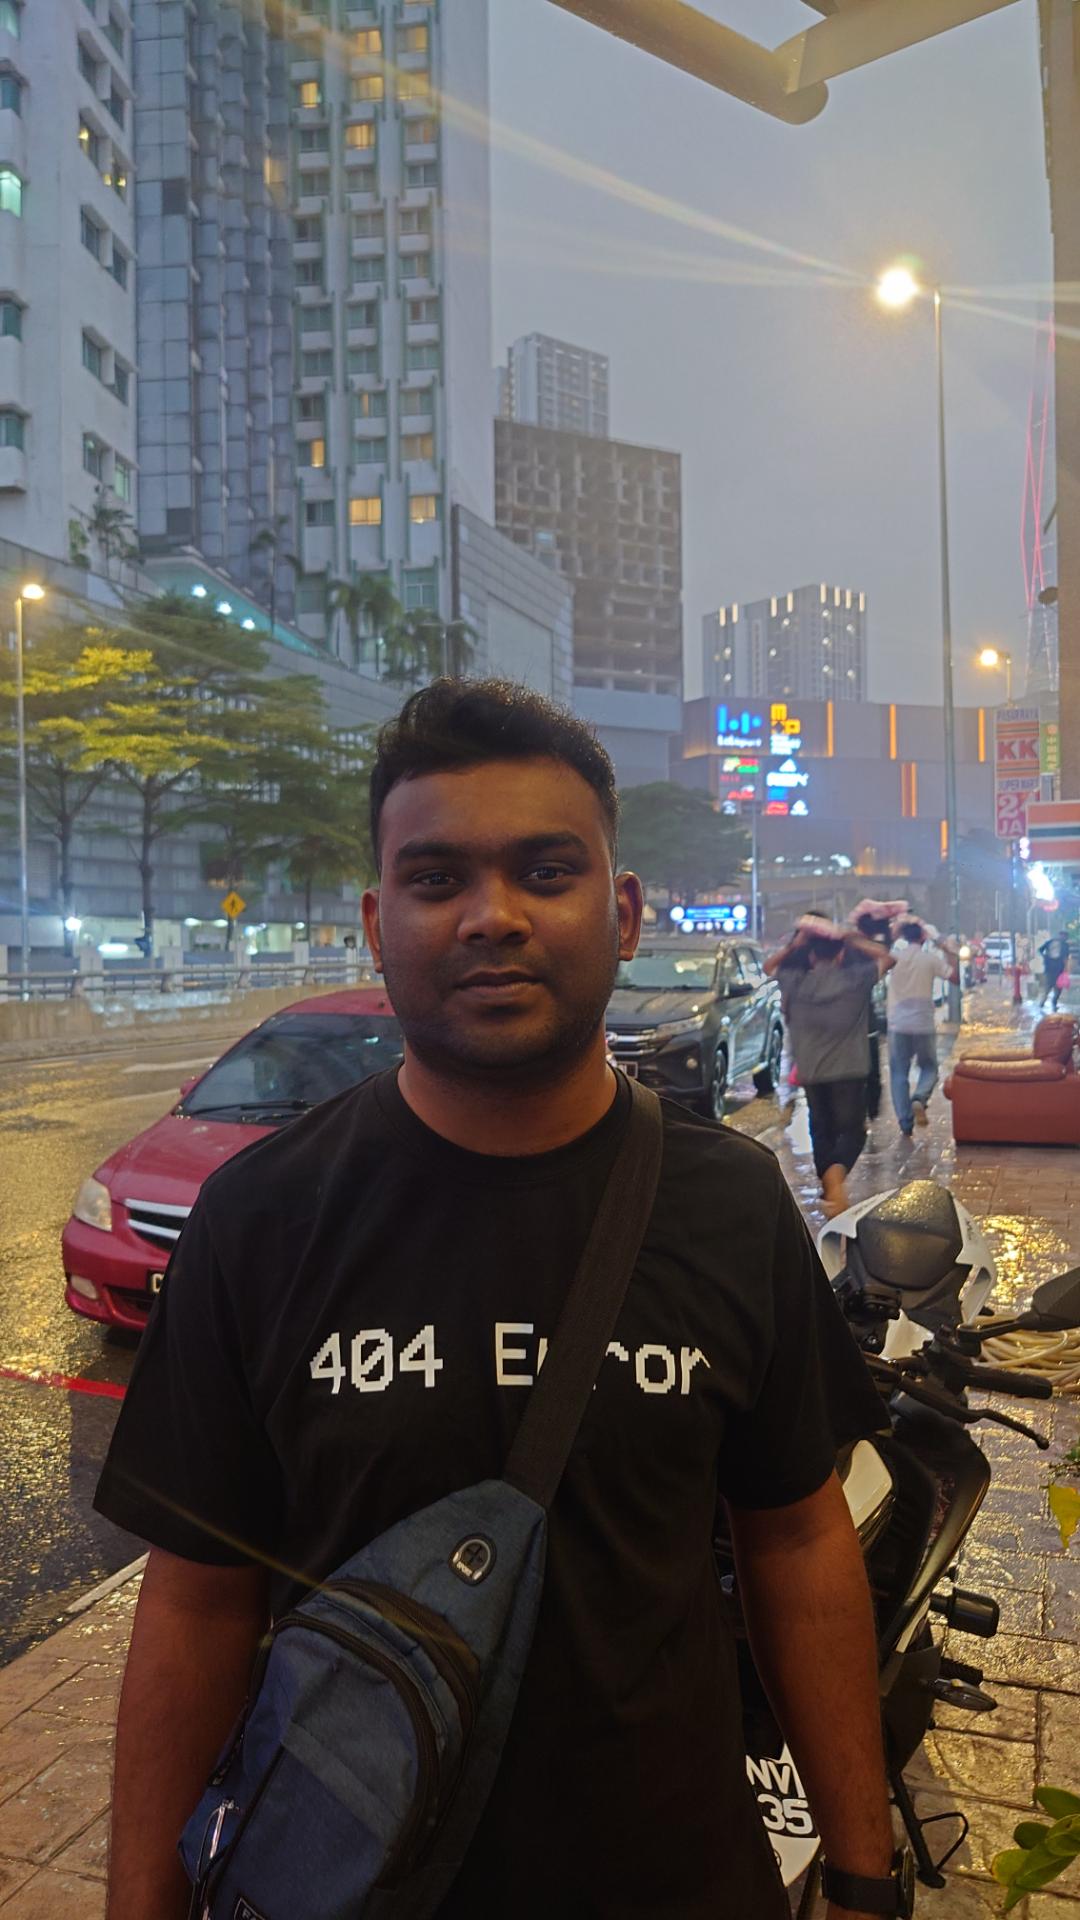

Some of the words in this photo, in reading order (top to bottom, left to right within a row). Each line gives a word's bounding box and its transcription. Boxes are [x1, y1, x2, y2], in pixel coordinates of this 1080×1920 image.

[997, 740, 1038, 760] KK
[998, 819, 1024, 834] JA
[310, 1325, 443, 1394] 404
[495, 1322, 711, 1395] Eor
[757, 1793, 814, 1835] 35
